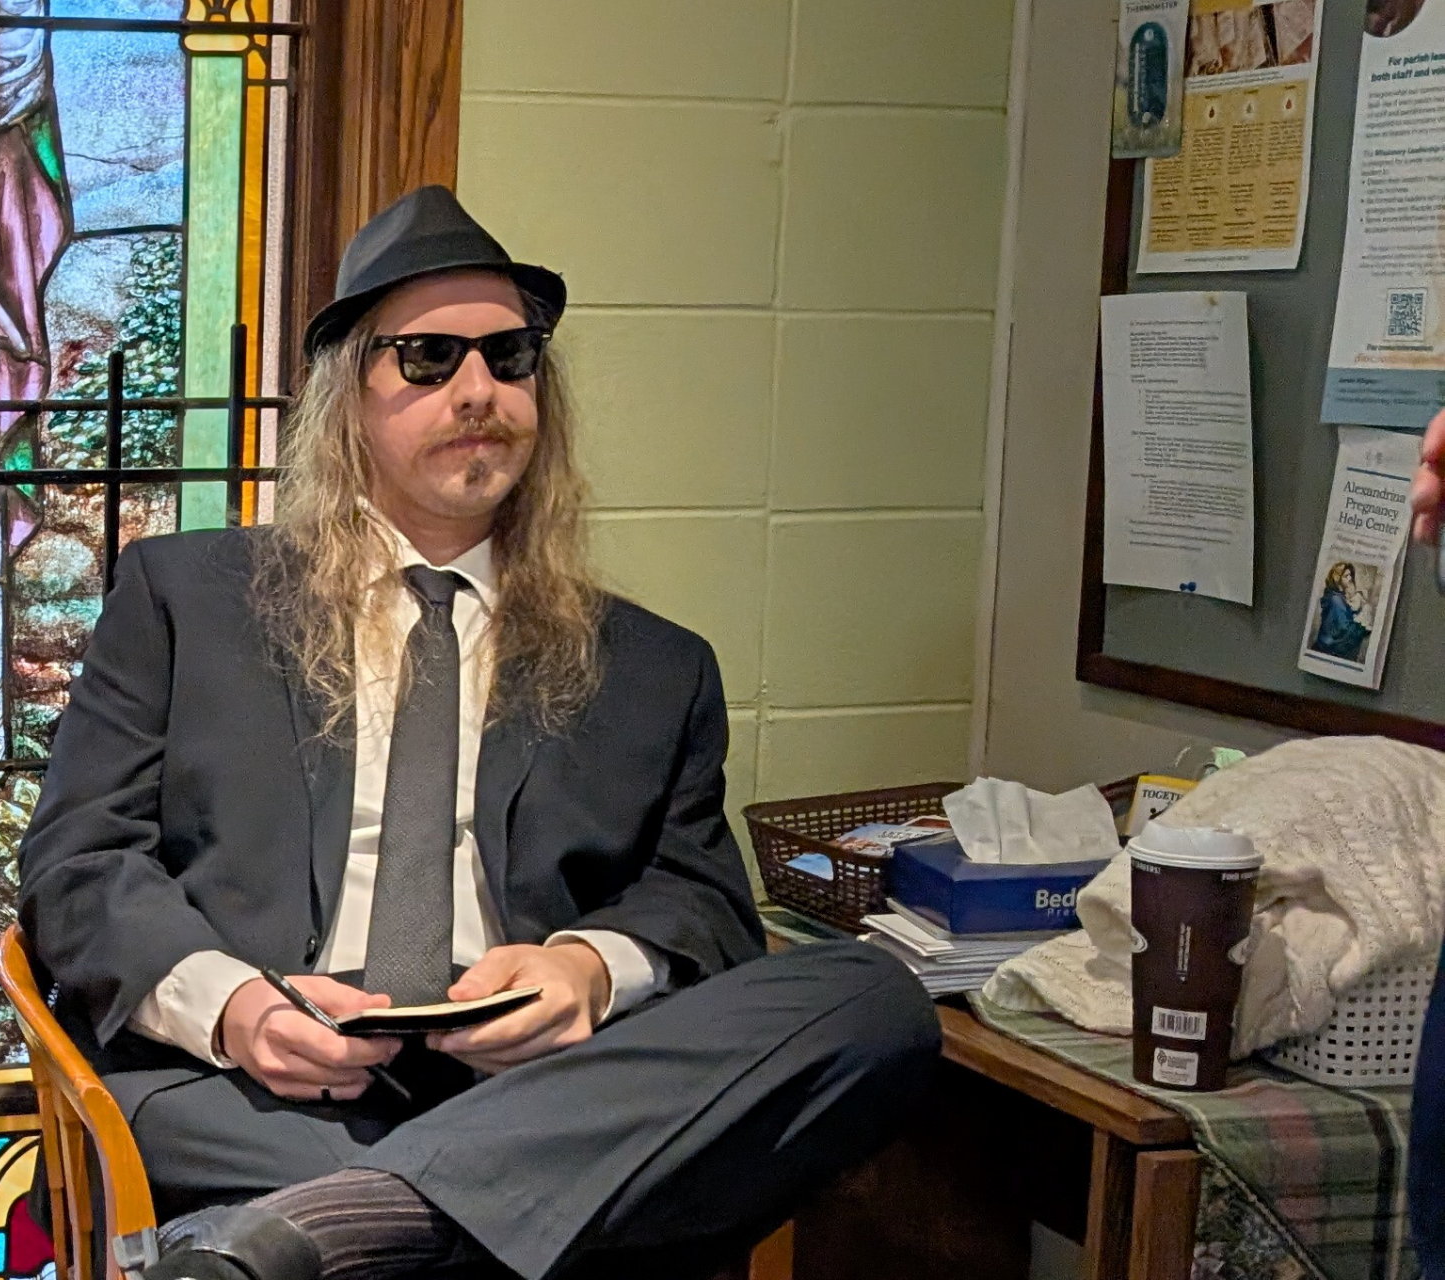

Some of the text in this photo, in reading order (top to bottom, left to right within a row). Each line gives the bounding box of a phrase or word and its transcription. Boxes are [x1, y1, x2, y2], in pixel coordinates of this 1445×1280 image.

[1343, 481, 1407, 504] Alexandrina
[1345, 497, 1399, 521] Pregnancy
[1338, 512, 1399, 535] Help Center
[1035, 887, 1077, 909] Bed
